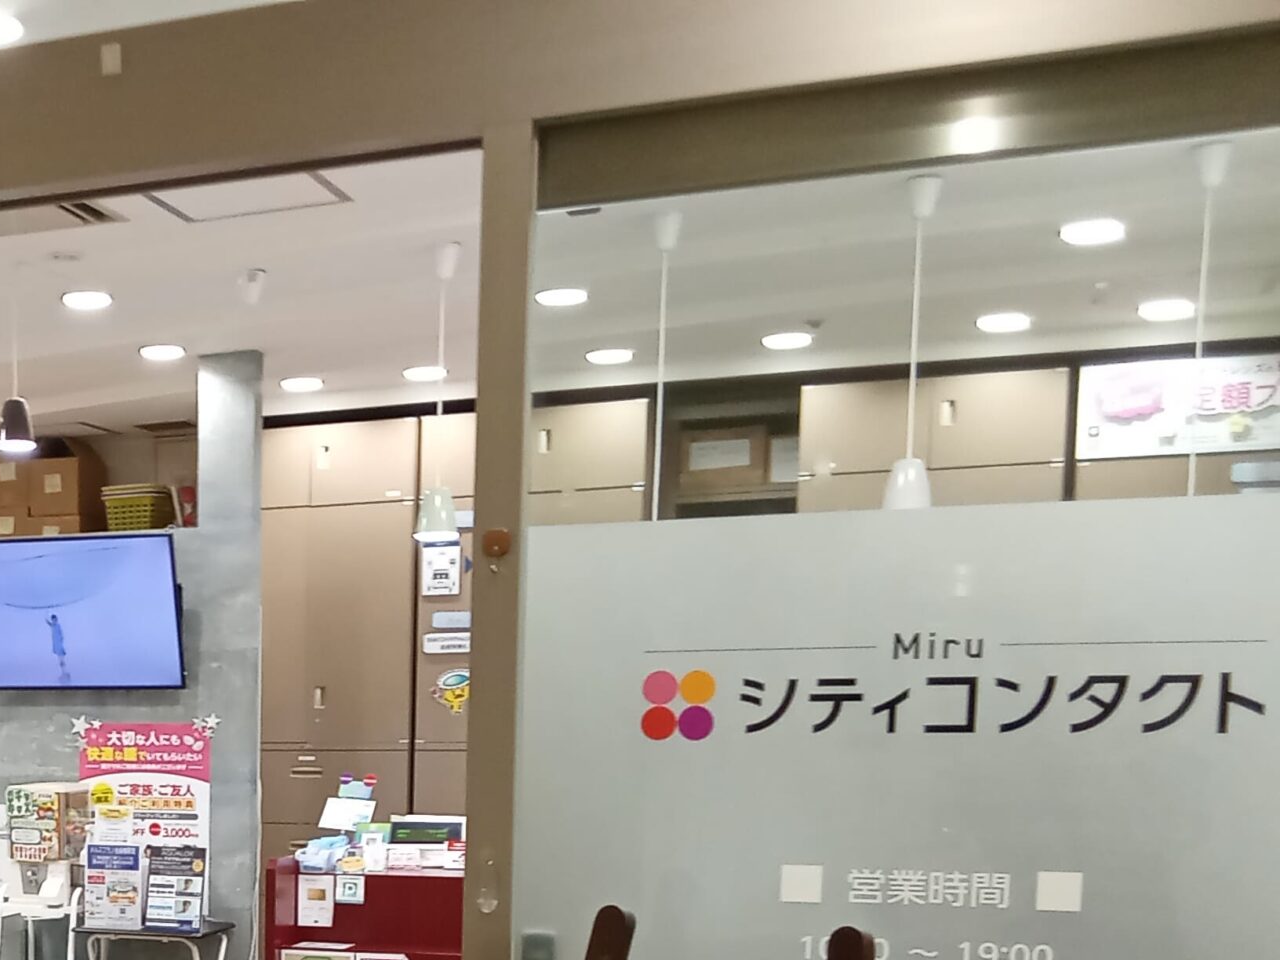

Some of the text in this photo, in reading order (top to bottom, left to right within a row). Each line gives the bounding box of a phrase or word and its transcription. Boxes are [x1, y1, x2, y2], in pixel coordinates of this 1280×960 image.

[892, 632, 985, 660] Miru
[738, 672, 1266, 735] シティコンタクト
[847, 868, 1011, 908] 営業時間
